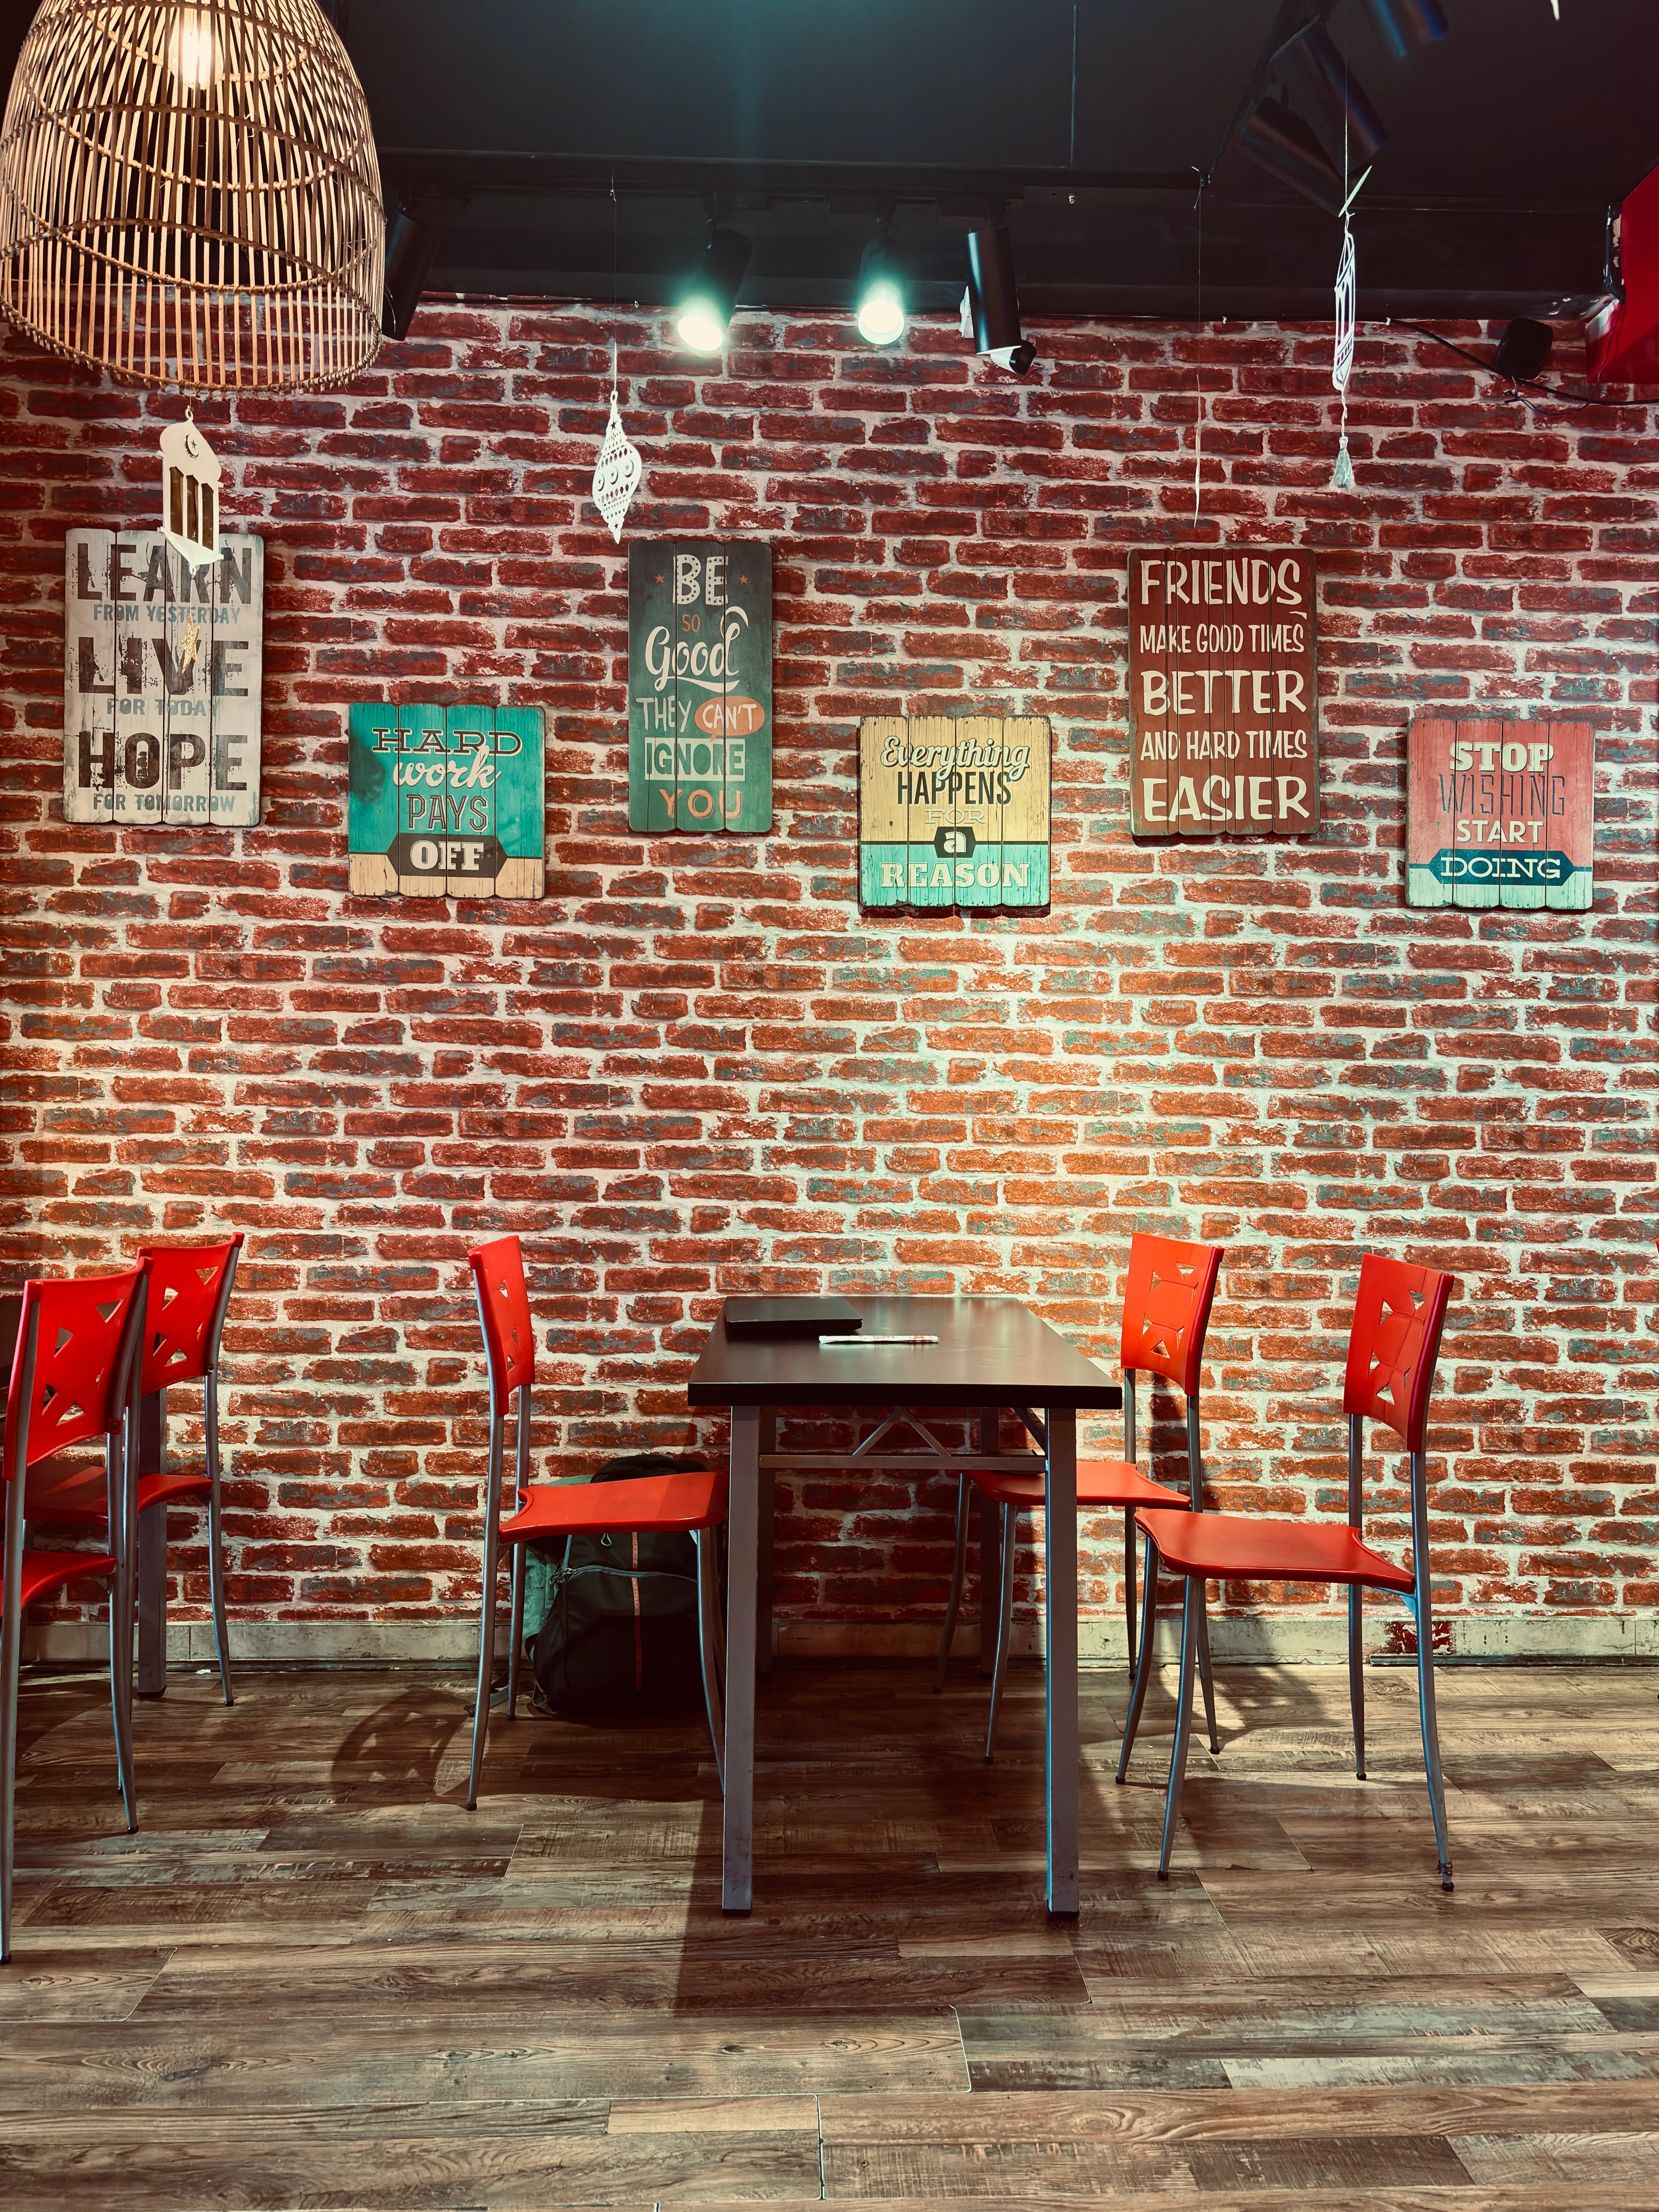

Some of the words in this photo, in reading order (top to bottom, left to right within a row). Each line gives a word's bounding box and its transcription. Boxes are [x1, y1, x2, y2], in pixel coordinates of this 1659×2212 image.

[672, 554, 729, 606] BE
[1140, 557, 1302, 605] FRIENDS
[93, 604, 139, 621] FROM
[146, 605, 241, 624] YESTERDAY
[681, 614, 701, 633] SO
[645, 606, 749, 692] Good
[1140, 625, 1192, 654] MAKE
[1196, 623, 1243, 653] GOOD
[1248, 623, 1305, 653] TIMES
[78, 637, 249, 697] LIVE
[107, 698, 145, 716] FOR
[155, 699, 221, 717] TODAY
[1141, 670, 1306, 716] BETTER
[636, 695, 692, 733] THEY
[702, 703, 757, 731] CAN'T
[372, 727, 523, 756] HARD
[1141, 731, 1179, 761] AND
[1187, 730, 1240, 761] HARD
[1245, 729, 1307, 759] TIMES
[1449, 742, 1554, 772] STOP
[79, 732, 248, 791] HOPE
[393, 745, 501, 789] work
[646, 742, 744, 776] IGNORE
[880, 736, 1030, 781] Everything
[93, 794, 126, 811] FOR
[136, 794, 235, 813] TOMORROW
[658, 789, 743, 819] YOU
[898, 771, 1012, 805] HAPPENS
[1142, 775, 1310, 822] EASIER
[1439, 774, 1565, 816] WISHING
[406, 794, 489, 832] PAYS
[925, 809, 985, 824] FOR
[943, 831, 966, 853] a
[1456, 819, 1543, 843] START
[410, 840, 484, 871] OFF
[1440, 857, 1560, 879] DOING
[880, 863, 1030, 888] REASON
